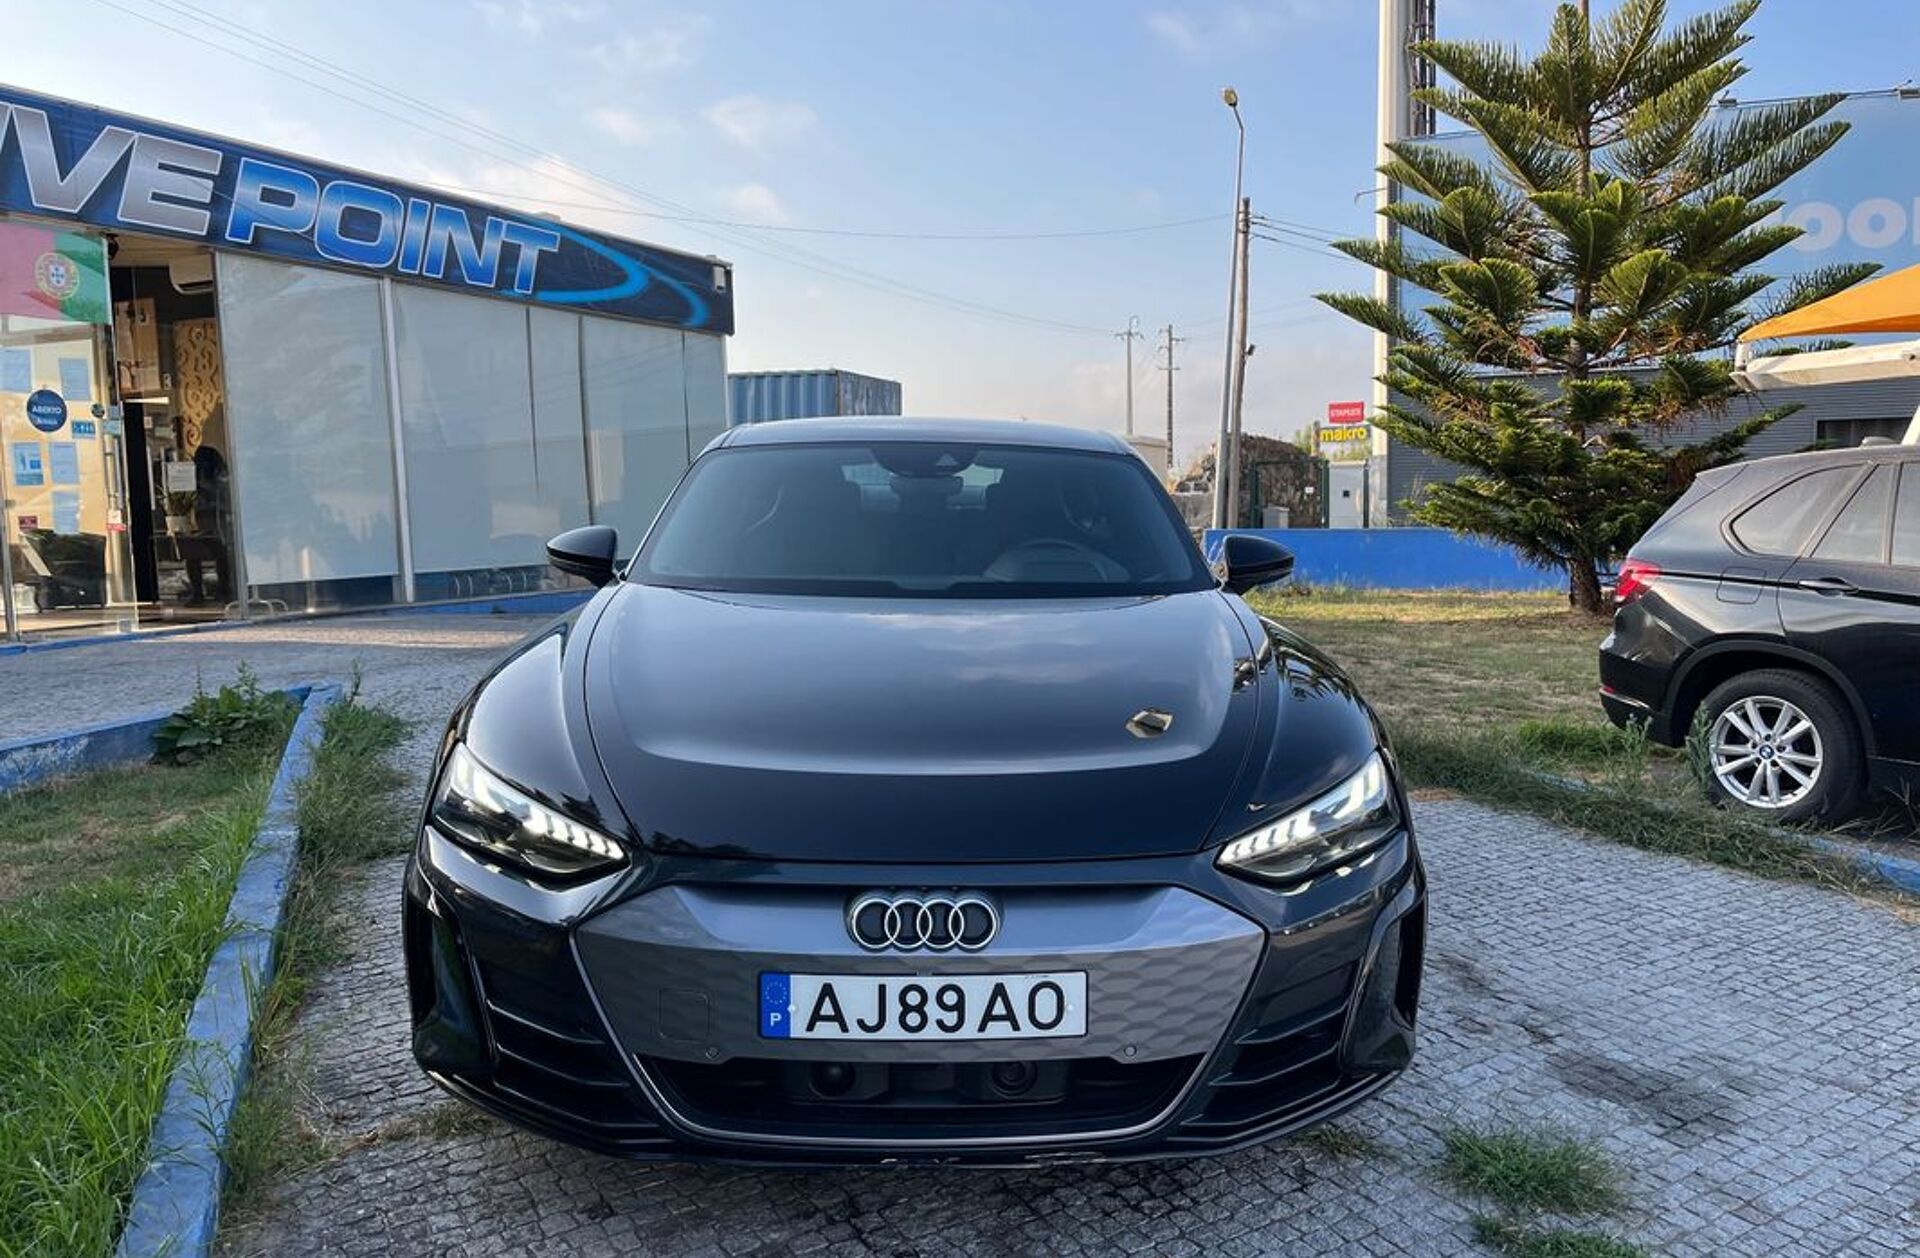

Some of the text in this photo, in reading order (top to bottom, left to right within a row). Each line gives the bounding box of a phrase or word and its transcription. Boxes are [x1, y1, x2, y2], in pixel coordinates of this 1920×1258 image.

[226, 157, 561, 295] POINT
[1321, 428, 1367, 441] makro
[770, 1013, 783, 1027] P
